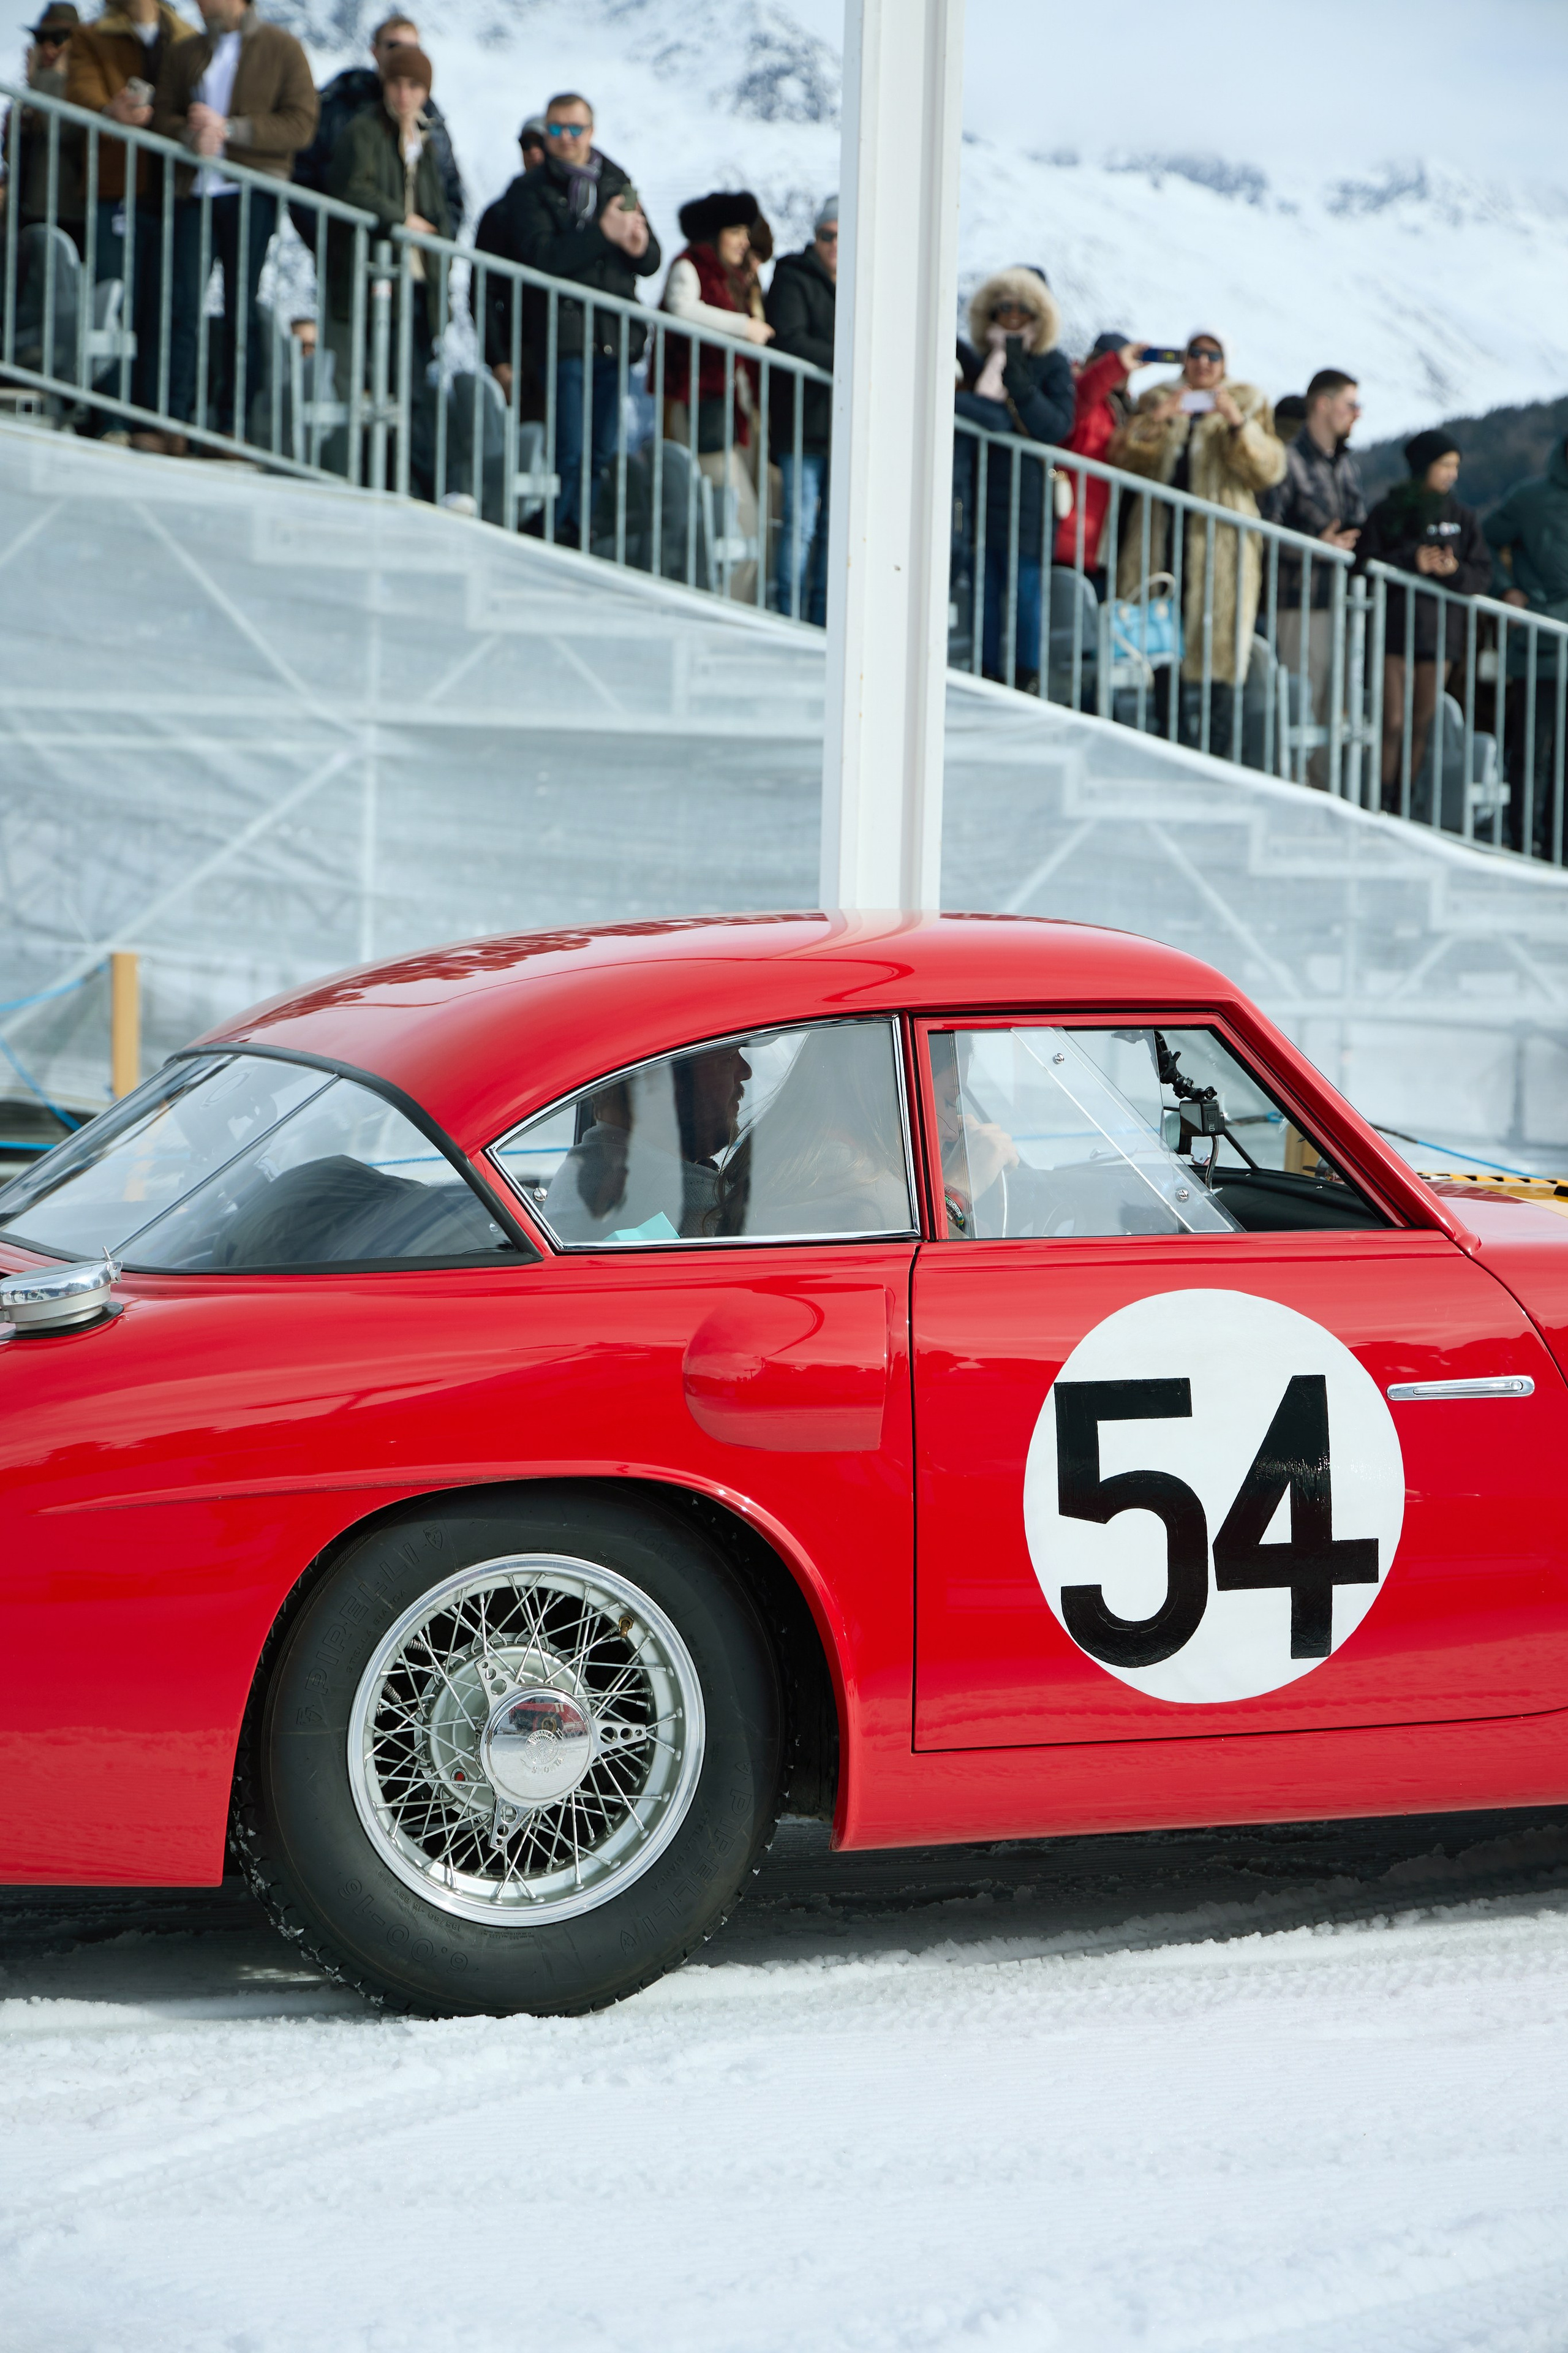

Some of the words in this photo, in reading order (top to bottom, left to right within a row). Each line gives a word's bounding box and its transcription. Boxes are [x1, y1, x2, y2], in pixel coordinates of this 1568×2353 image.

[1054, 1374, 1379, 1669] 54
[306, 1541, 420, 1695] PIRELLI
[346, 1627, 373, 1674] STELLA
[373, 1588, 408, 1624] BIANCA
[642, 1788, 753, 1938] PIRELLI
[651, 1855, 687, 1892] BIANCA
[685, 1809, 710, 1852] STELLA
